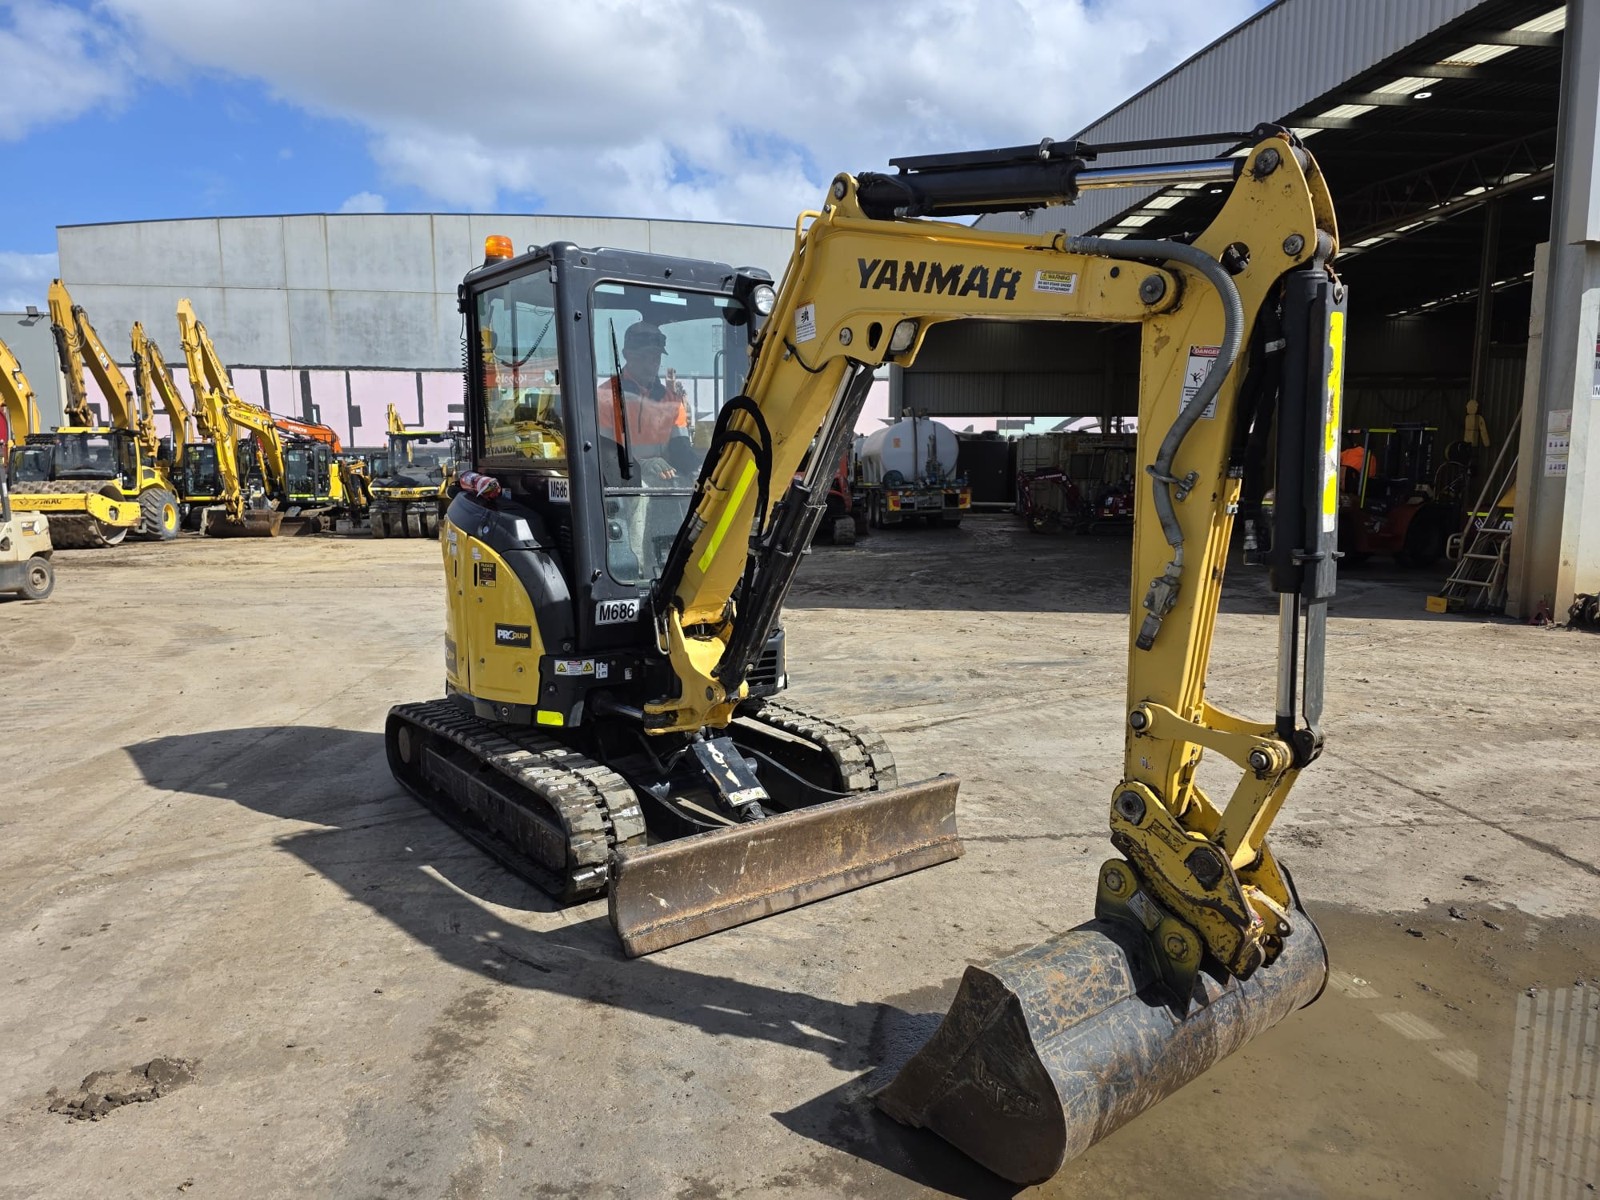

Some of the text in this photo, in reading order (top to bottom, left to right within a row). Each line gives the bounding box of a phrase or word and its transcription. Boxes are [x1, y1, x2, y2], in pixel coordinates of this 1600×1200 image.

[857, 258, 1022, 300] YANMAR
[288, 425, 307, 433] HITACHI
[550, 481, 567, 498] M686
[599, 603, 635, 621] M686
